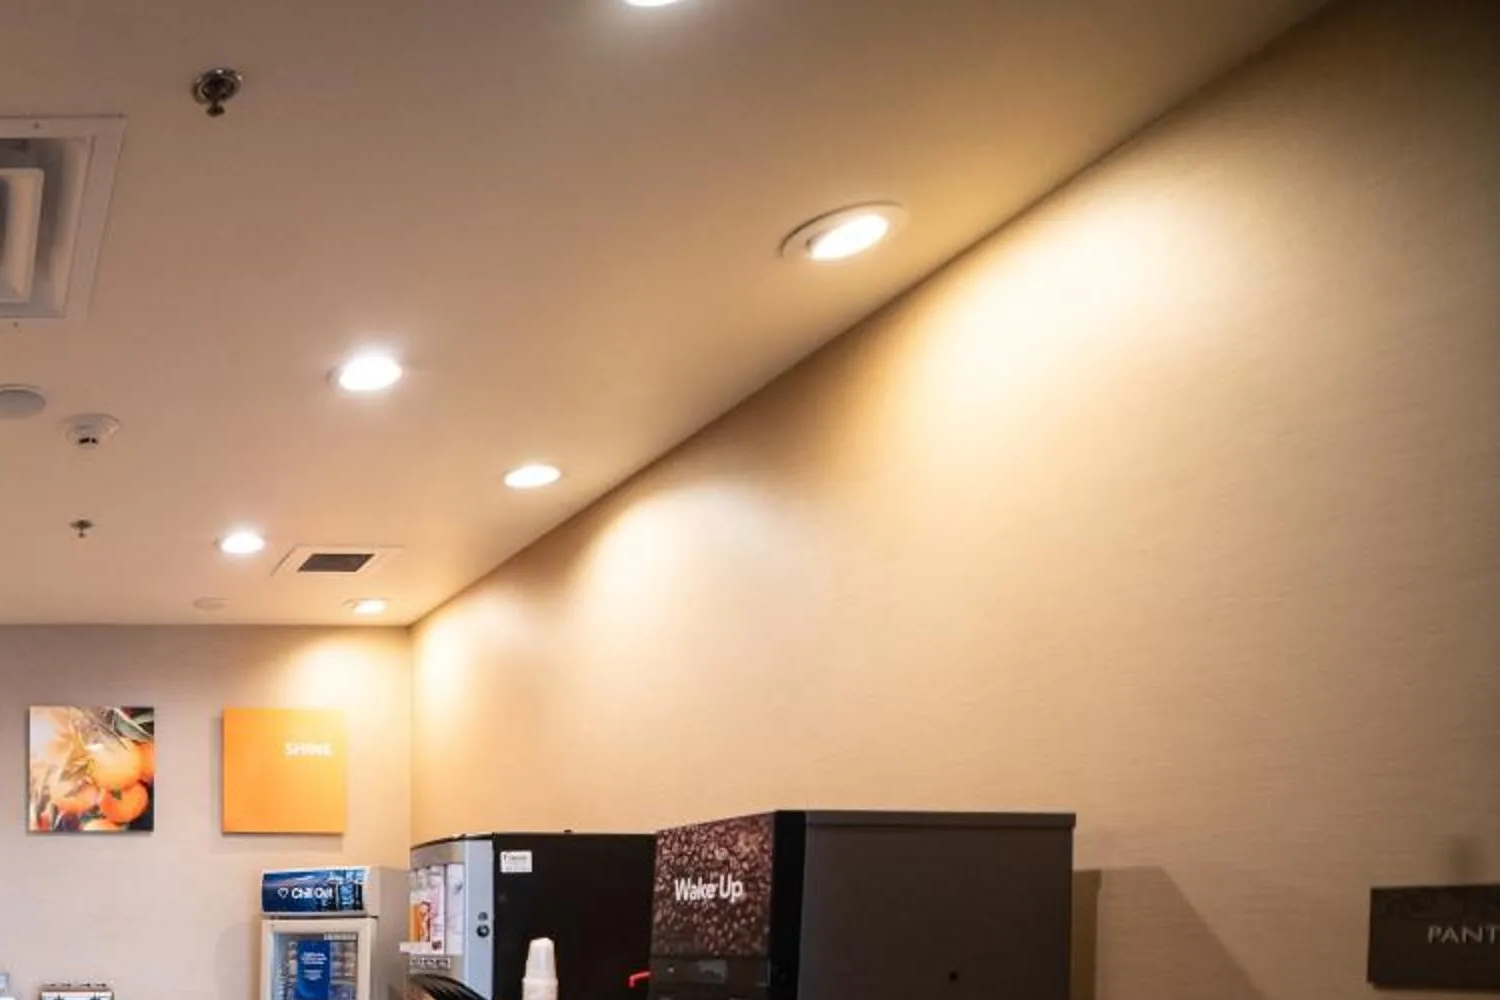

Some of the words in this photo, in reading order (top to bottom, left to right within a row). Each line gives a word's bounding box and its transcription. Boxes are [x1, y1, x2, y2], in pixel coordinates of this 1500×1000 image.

[675, 876, 718, 901] Wake
[720, 873, 743, 903] Up
[1427, 924, 1500, 944] PANT
